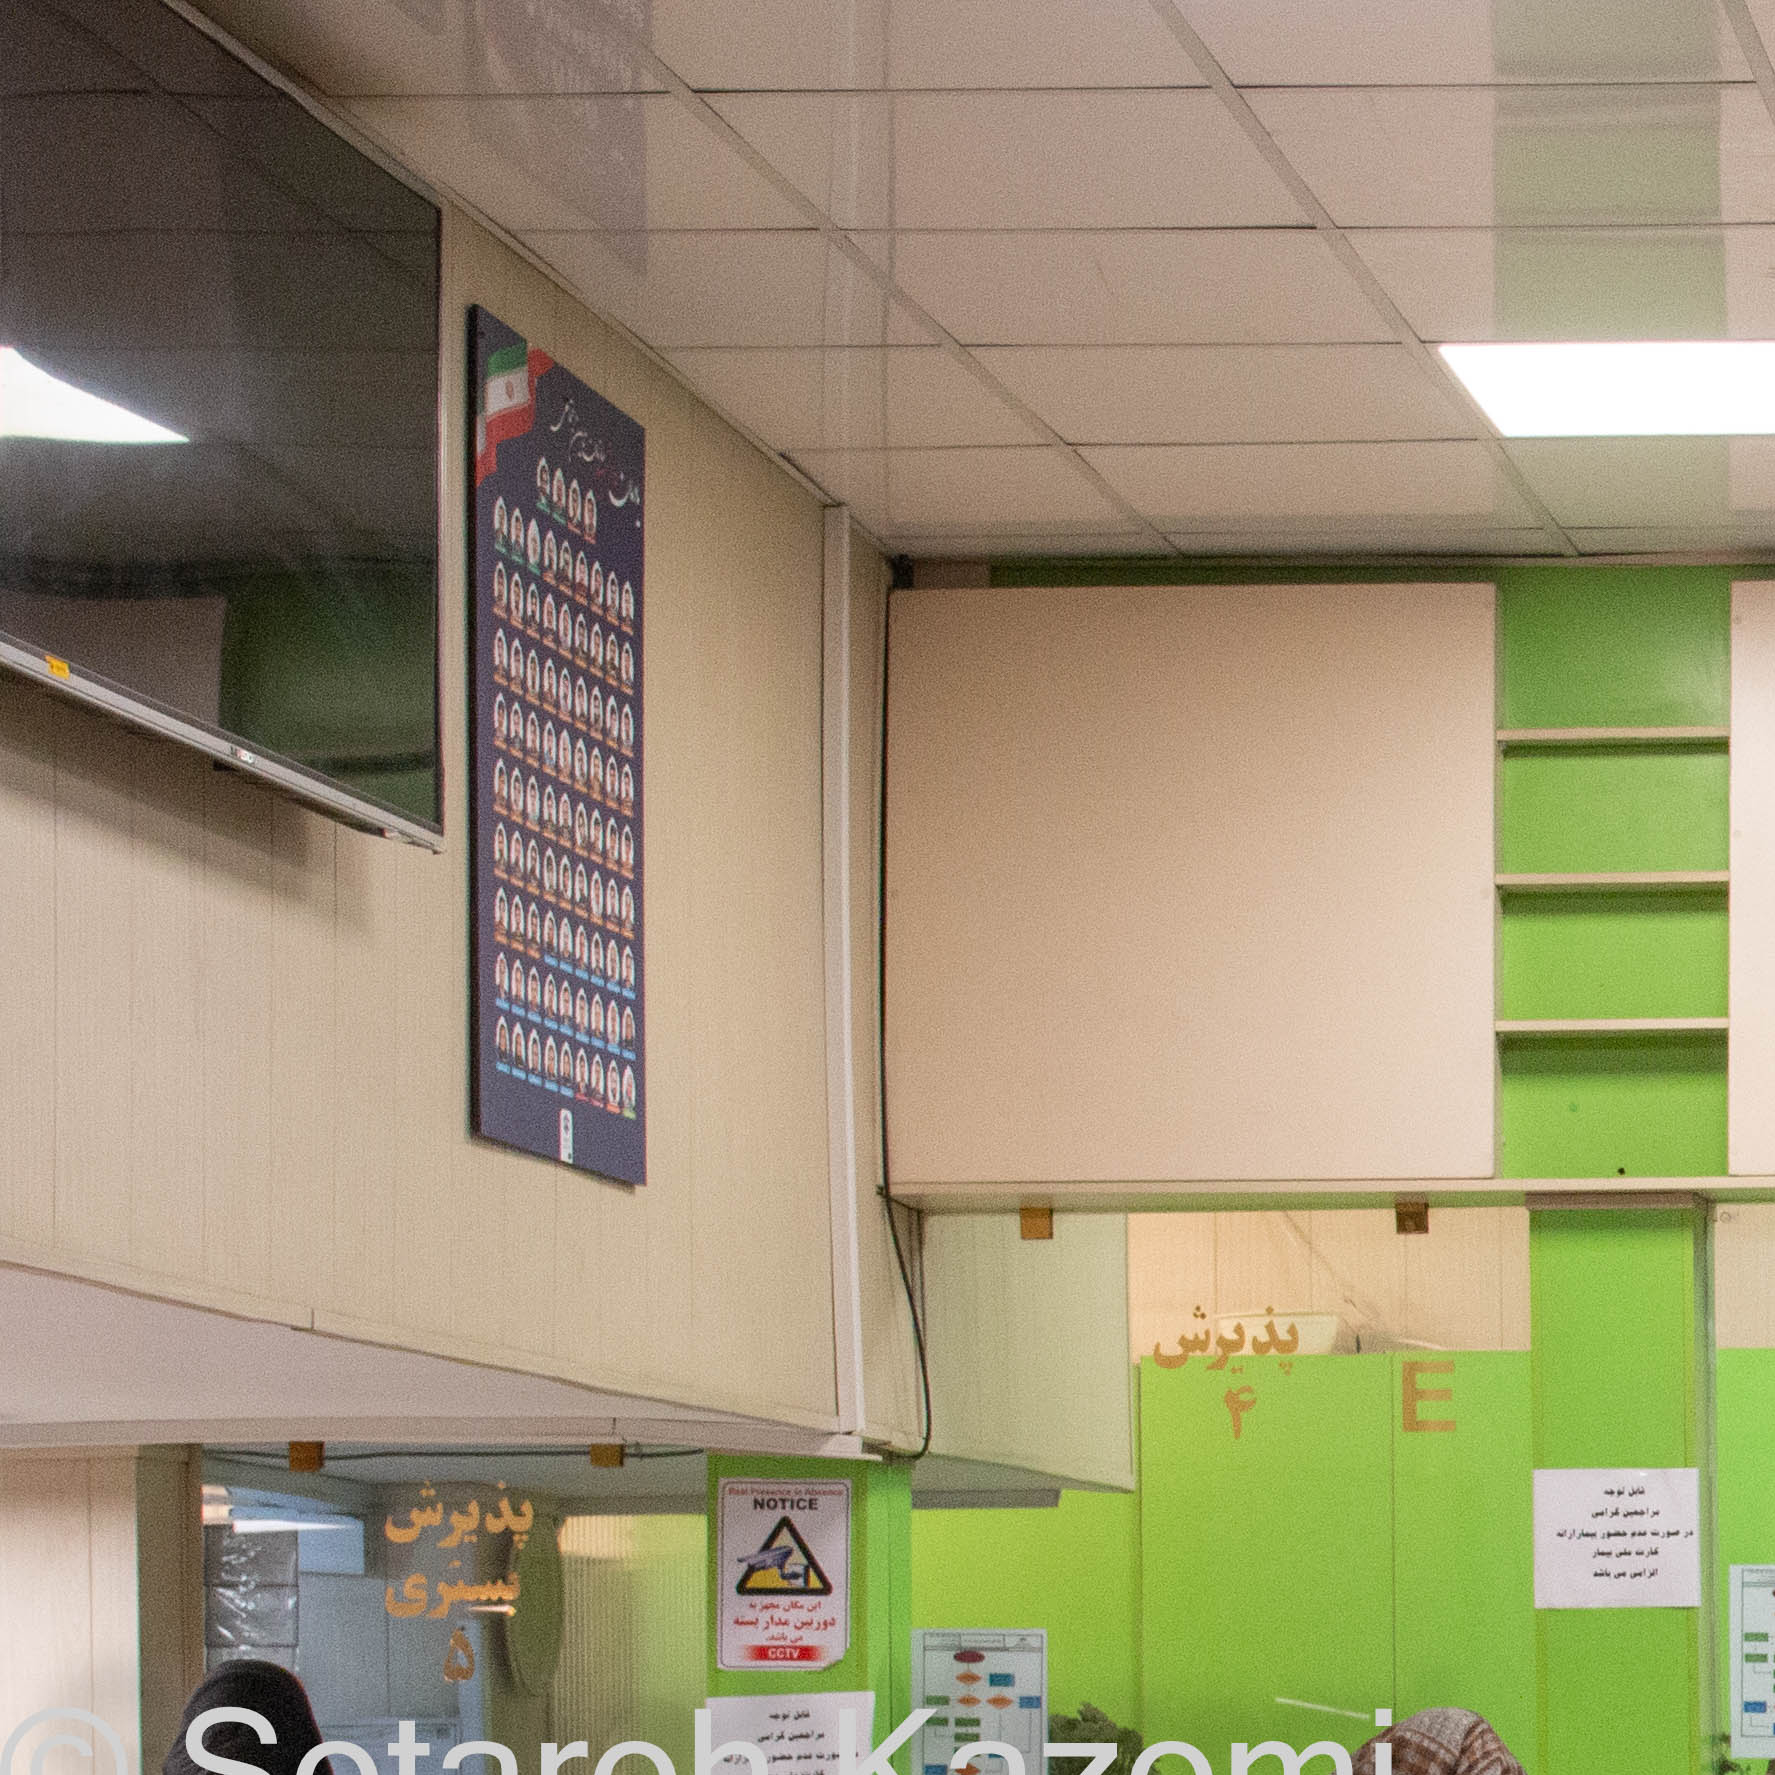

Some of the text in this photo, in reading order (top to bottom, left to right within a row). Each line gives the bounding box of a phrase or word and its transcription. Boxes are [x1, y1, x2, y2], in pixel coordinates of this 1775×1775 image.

[1153, 1304, 1299, 1376] پذیرش
[1224, 1385, 1257, 1440] ۴
[1402, 1360, 1456, 1432] E
[384, 1479, 534, 1551] پذیرش
[753, 1497, 818, 1511] NOTICE
[384, 1559, 521, 1619] بستری
[733, 1614, 836, 1631] دوربین مدار بسته
[443, 1627, 475, 1680] ۵
[768, 1647, 800, 1659] CCTV
